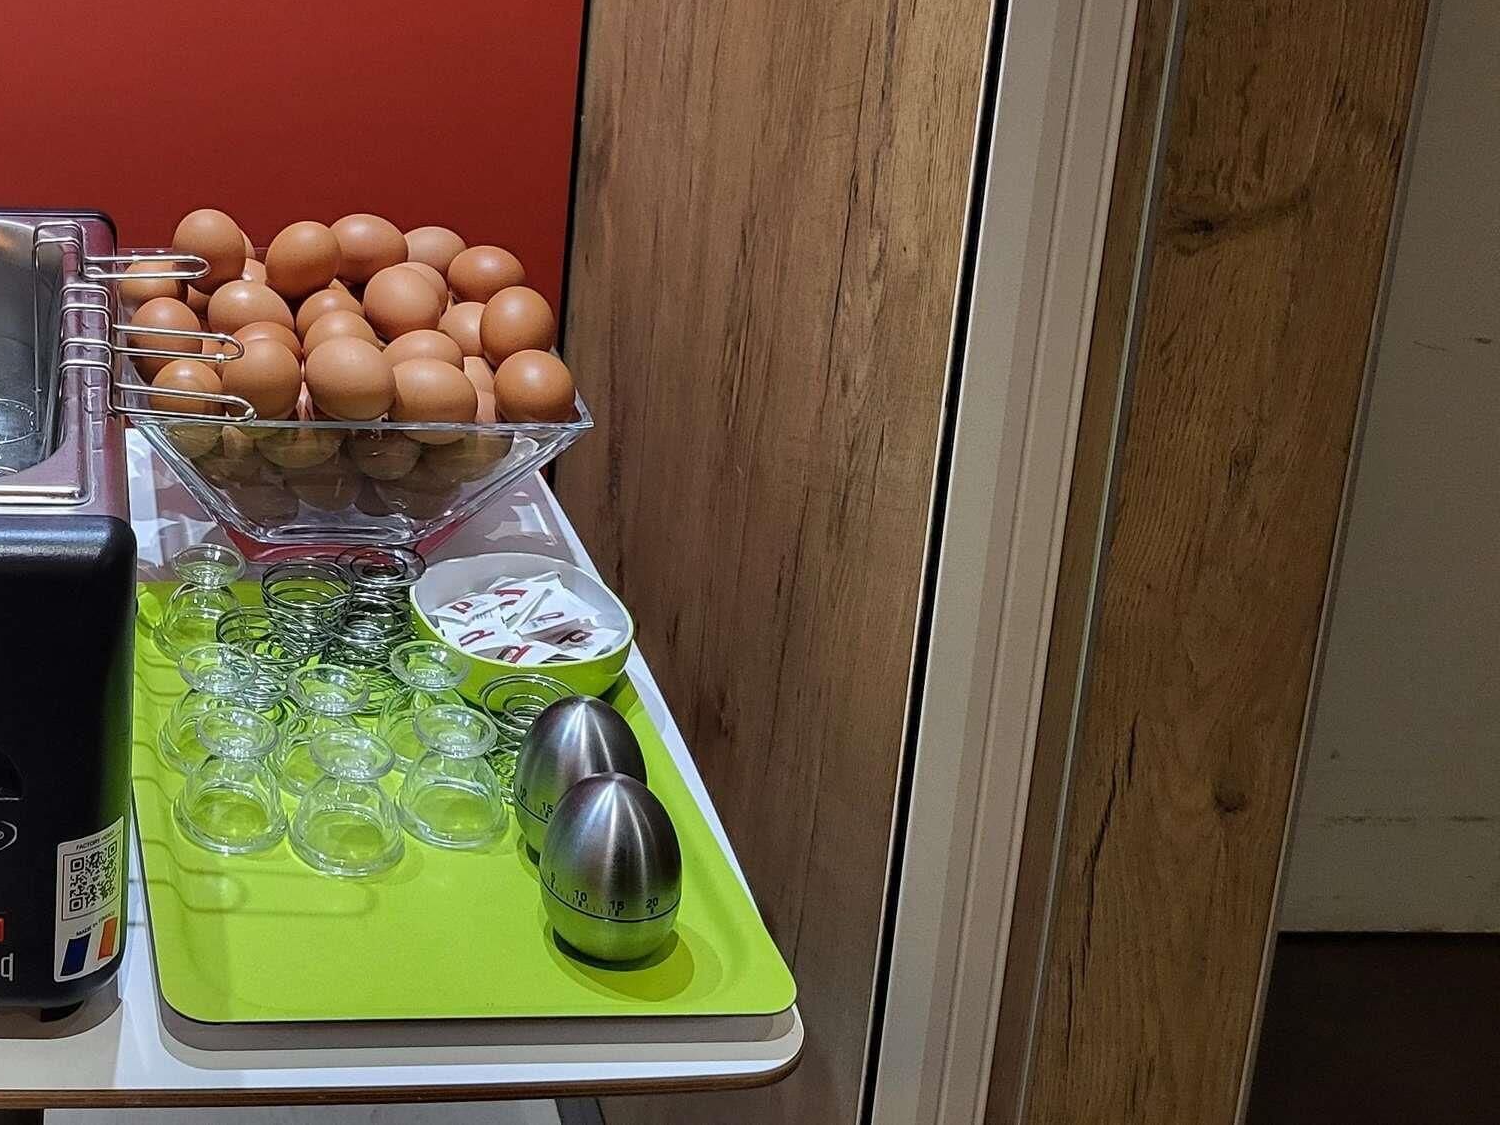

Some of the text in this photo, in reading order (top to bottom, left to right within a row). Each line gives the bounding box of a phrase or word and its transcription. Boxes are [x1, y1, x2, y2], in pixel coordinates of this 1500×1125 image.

[542, 801, 554, 814] 15
[574, 889, 588, 903] 10
[610, 899, 625, 911] 15
[645, 897, 659, 909] 20
